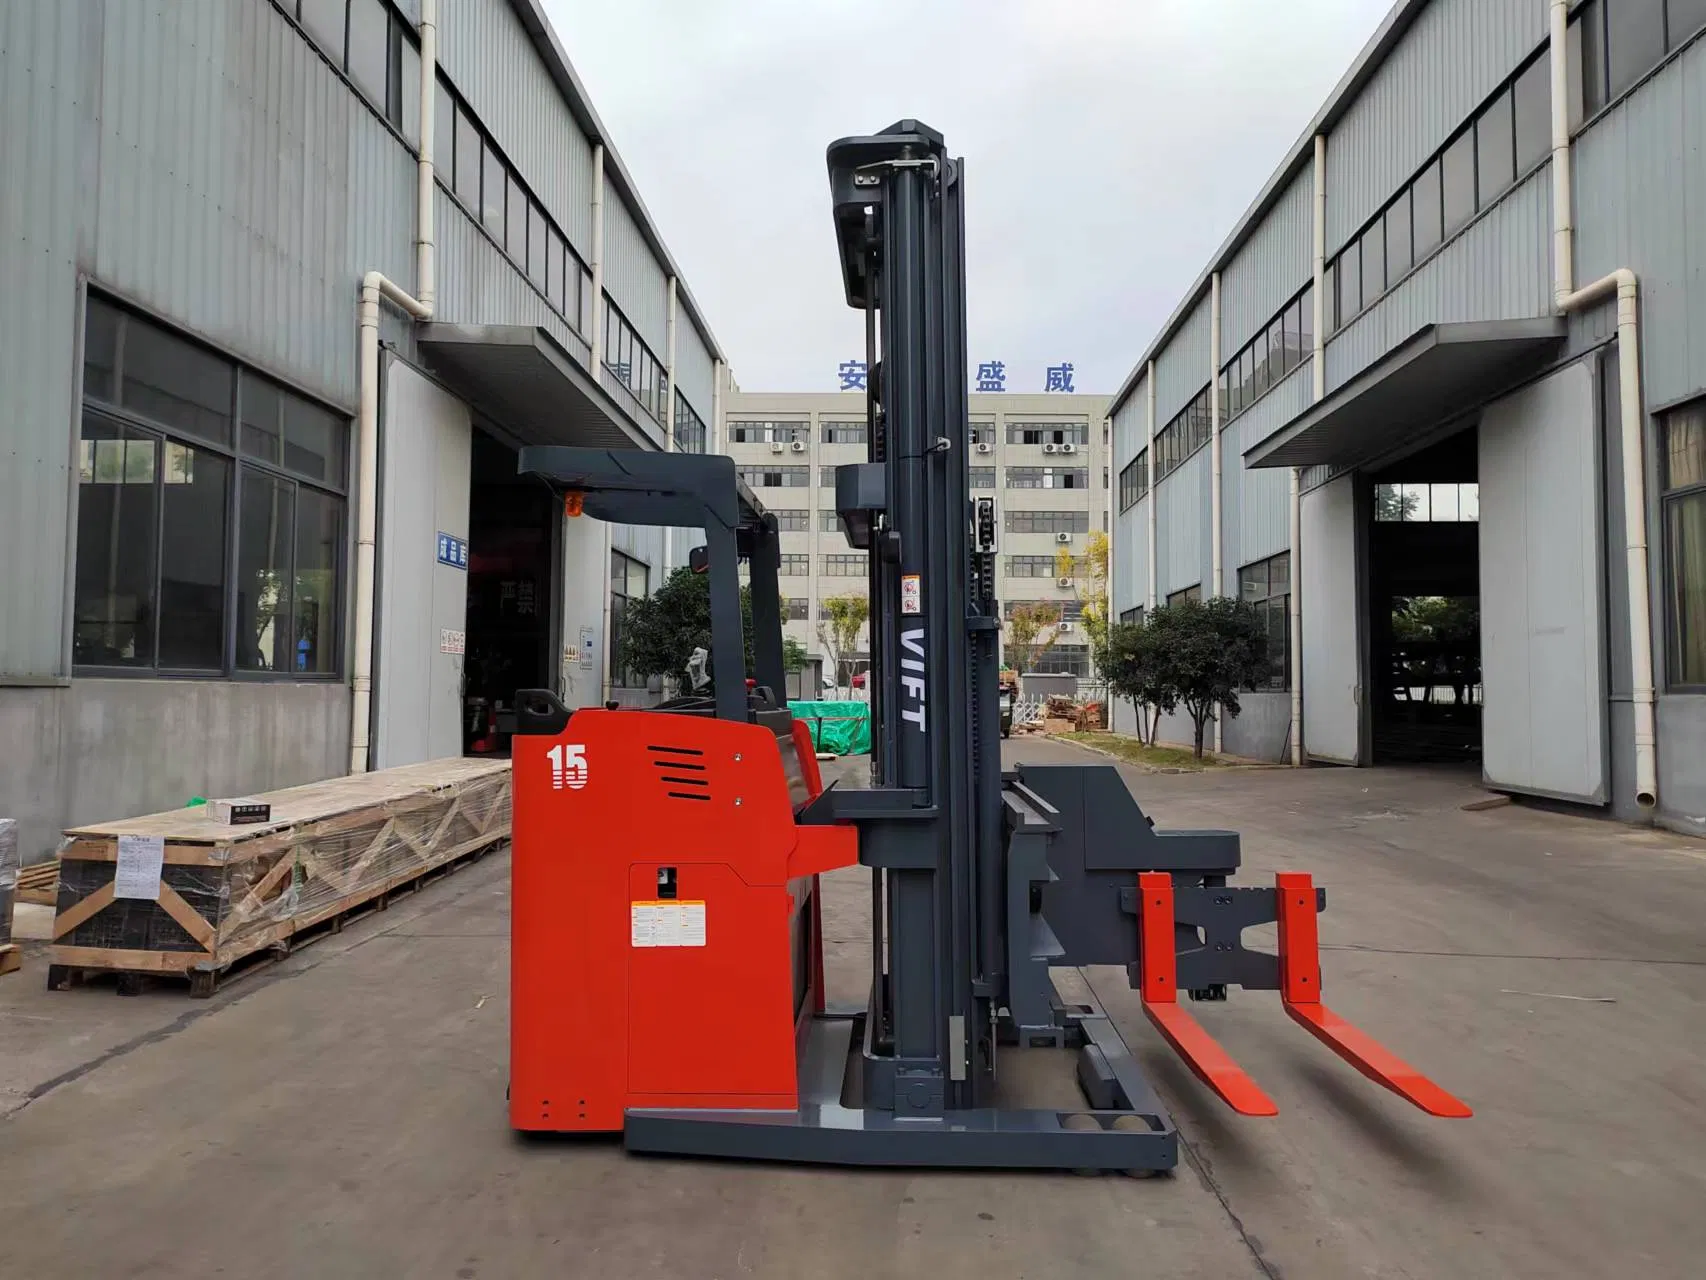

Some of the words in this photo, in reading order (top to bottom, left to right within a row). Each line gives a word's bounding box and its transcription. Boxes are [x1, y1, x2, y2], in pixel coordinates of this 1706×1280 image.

[838, 360, 1075, 393] 安盛威
[900, 628, 926, 733] VIFT
[546, 744, 588, 790] 15
